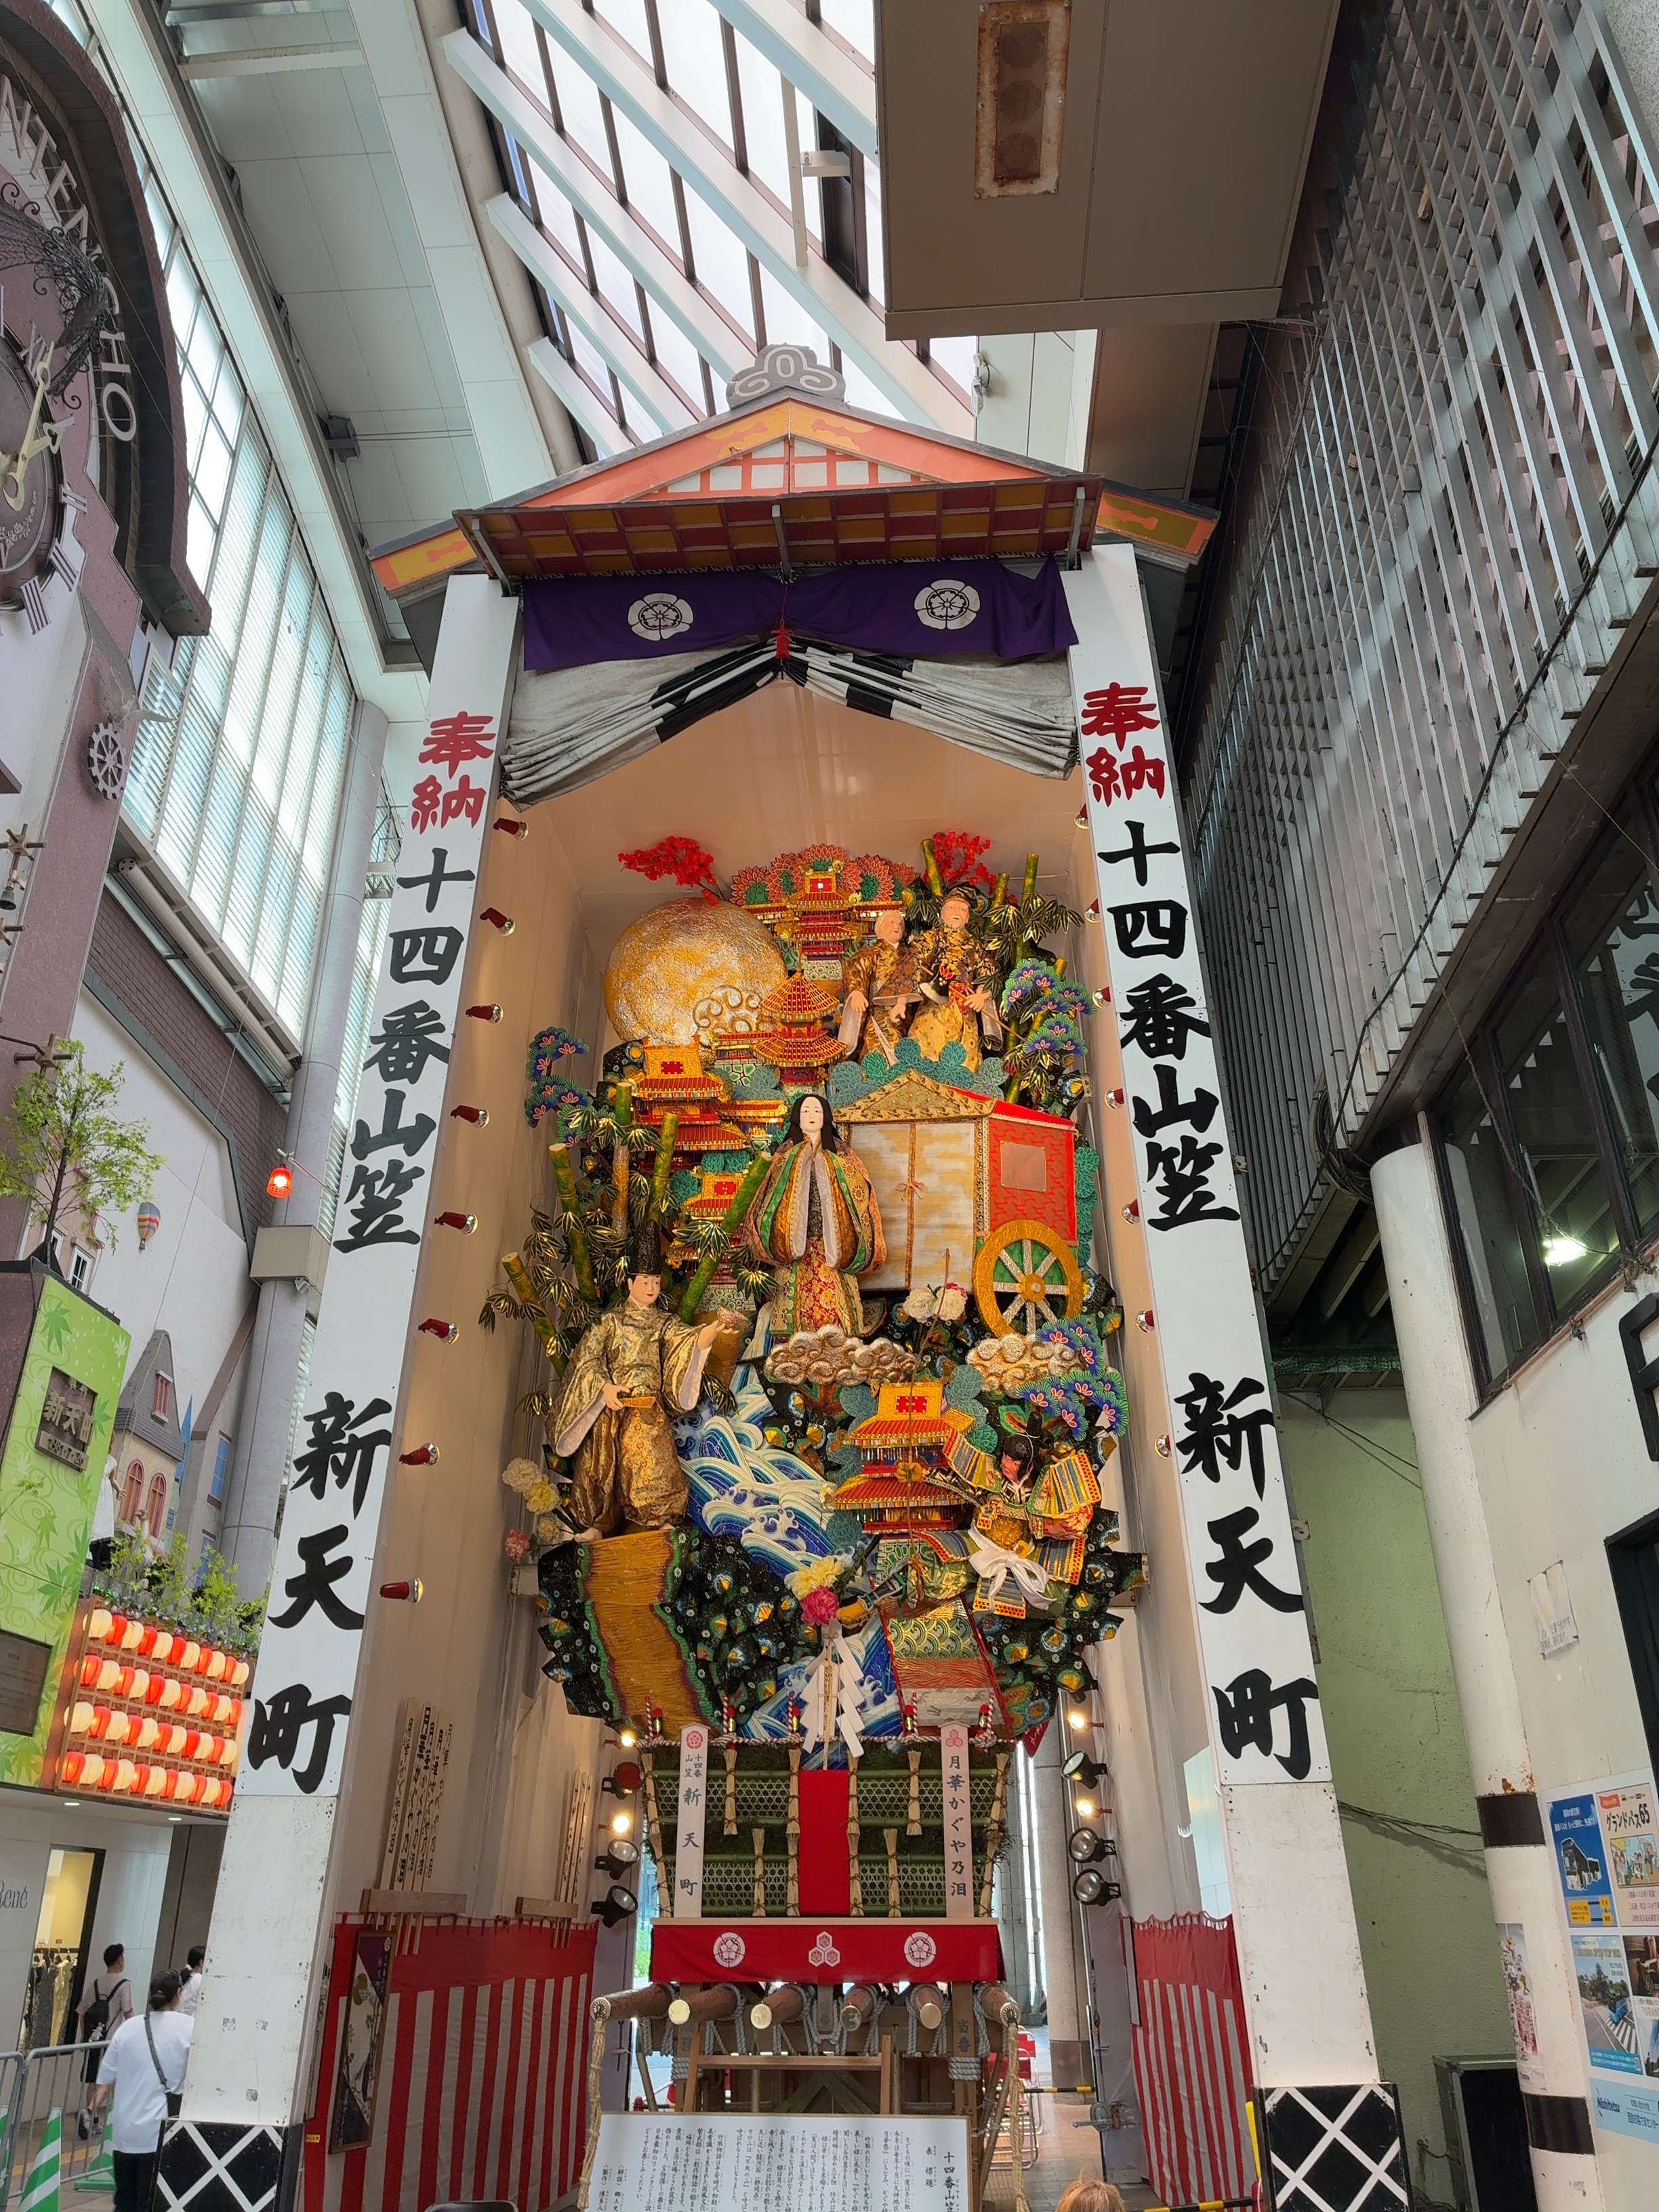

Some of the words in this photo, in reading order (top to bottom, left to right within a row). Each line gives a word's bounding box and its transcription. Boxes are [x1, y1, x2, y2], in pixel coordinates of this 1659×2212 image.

[411, 710, 497, 836] 奉納
[1081, 682, 1166, 808] 奉納
[333, 847, 476, 1254] 十四番山笠
[1098, 820, 1241, 1232] 十四番山笠
[43, 1390, 96, 1446] 新天町
[247, 1391, 392, 1795] 新天町
[1174, 1372, 1319, 1781] 新天町
[684, 1754, 693, 1778] 山笠
[693, 1754, 703, 1778] 十四番
[946, 1755, 967, 1897] 月華かぐや乃泪
[680, 1787, 702, 1896] 新天町
[957, 2018, 971, 2053] 当番
